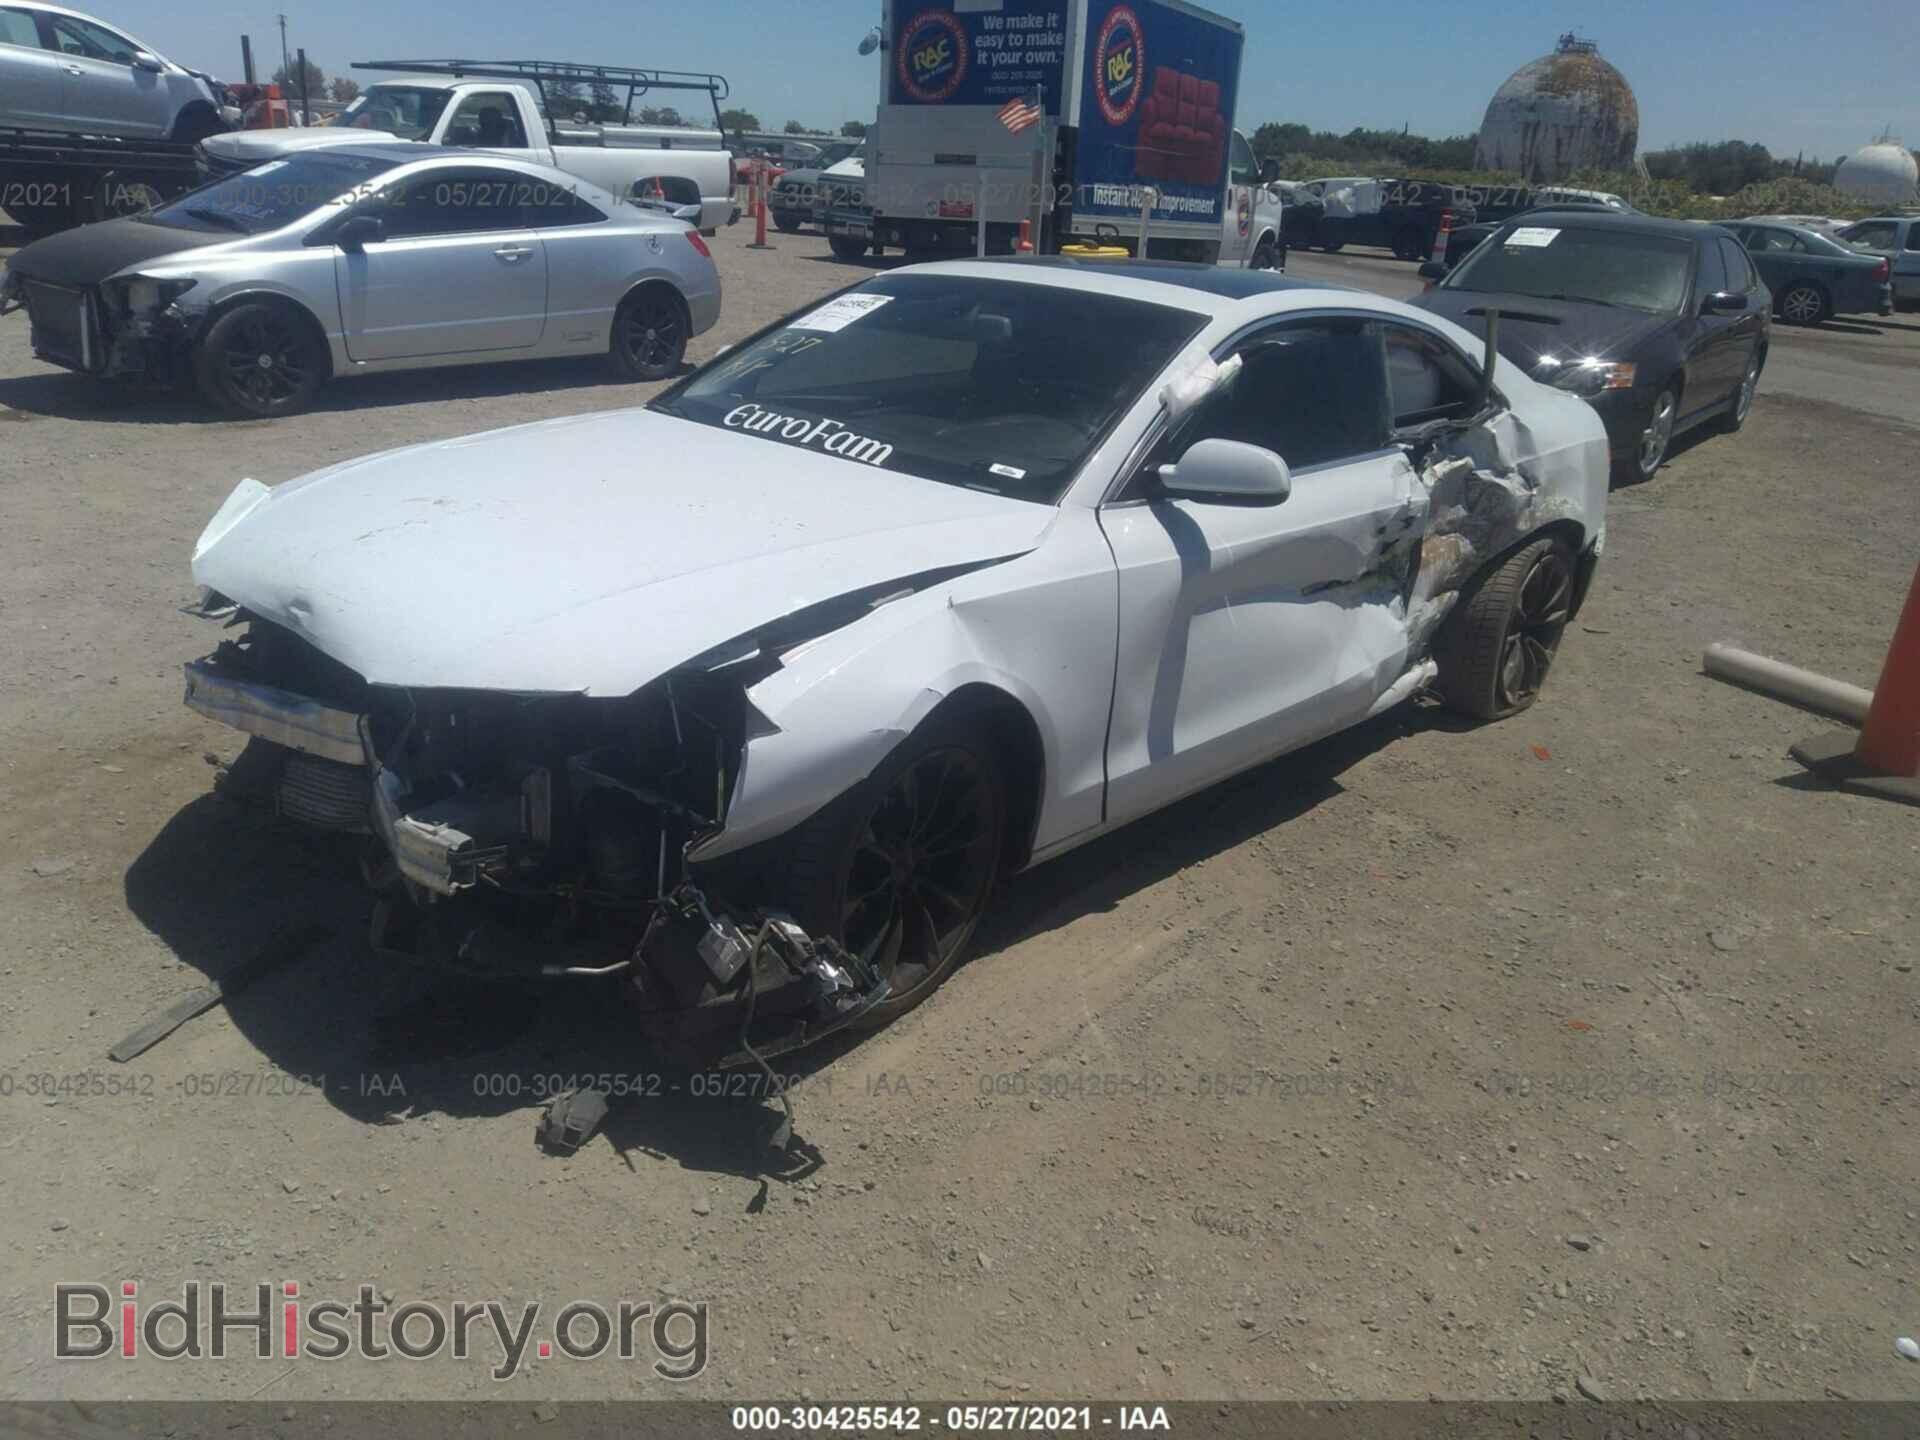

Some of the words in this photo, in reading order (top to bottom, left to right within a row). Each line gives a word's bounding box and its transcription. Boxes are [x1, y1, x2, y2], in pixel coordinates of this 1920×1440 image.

[983, 15, 1004, 29] We
[1006, 14, 1045, 29] make
[1046, 12, 1058, 28] it
[975, 34, 1005, 49] easy
[1008, 34, 1023, 47] to
[1026, 31, 1064, 46] make
[914, 38, 950, 71] RAC
[977, 50, 988, 65] it
[991, 51, 1021, 67] your
[1108, 47, 1132, 81] RAC
[1093, 183, 1129, 207] Instant
